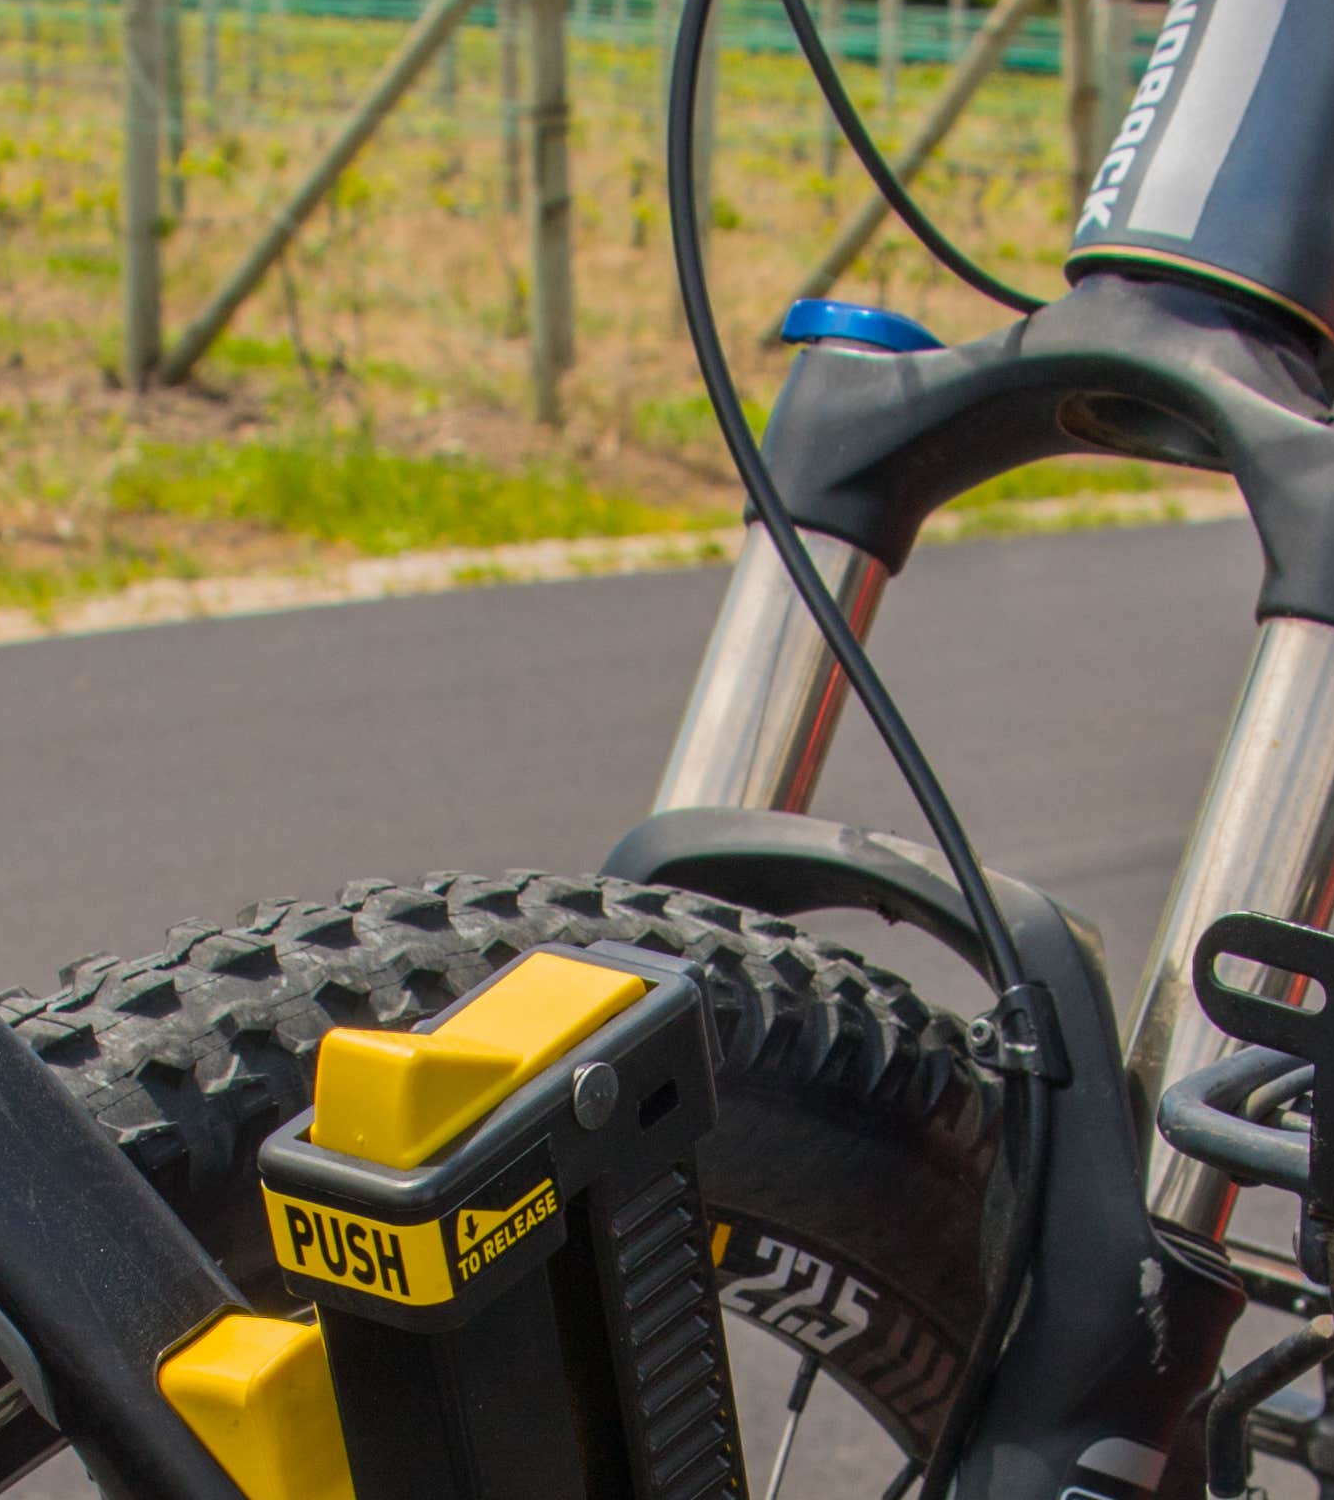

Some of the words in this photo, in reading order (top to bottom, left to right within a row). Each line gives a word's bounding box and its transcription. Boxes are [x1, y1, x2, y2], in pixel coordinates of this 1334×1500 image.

[286, 1202, 410, 1297] PUSH
[458, 1250, 479, 1281] TO
[482, 1190, 558, 1263] RELEASE
